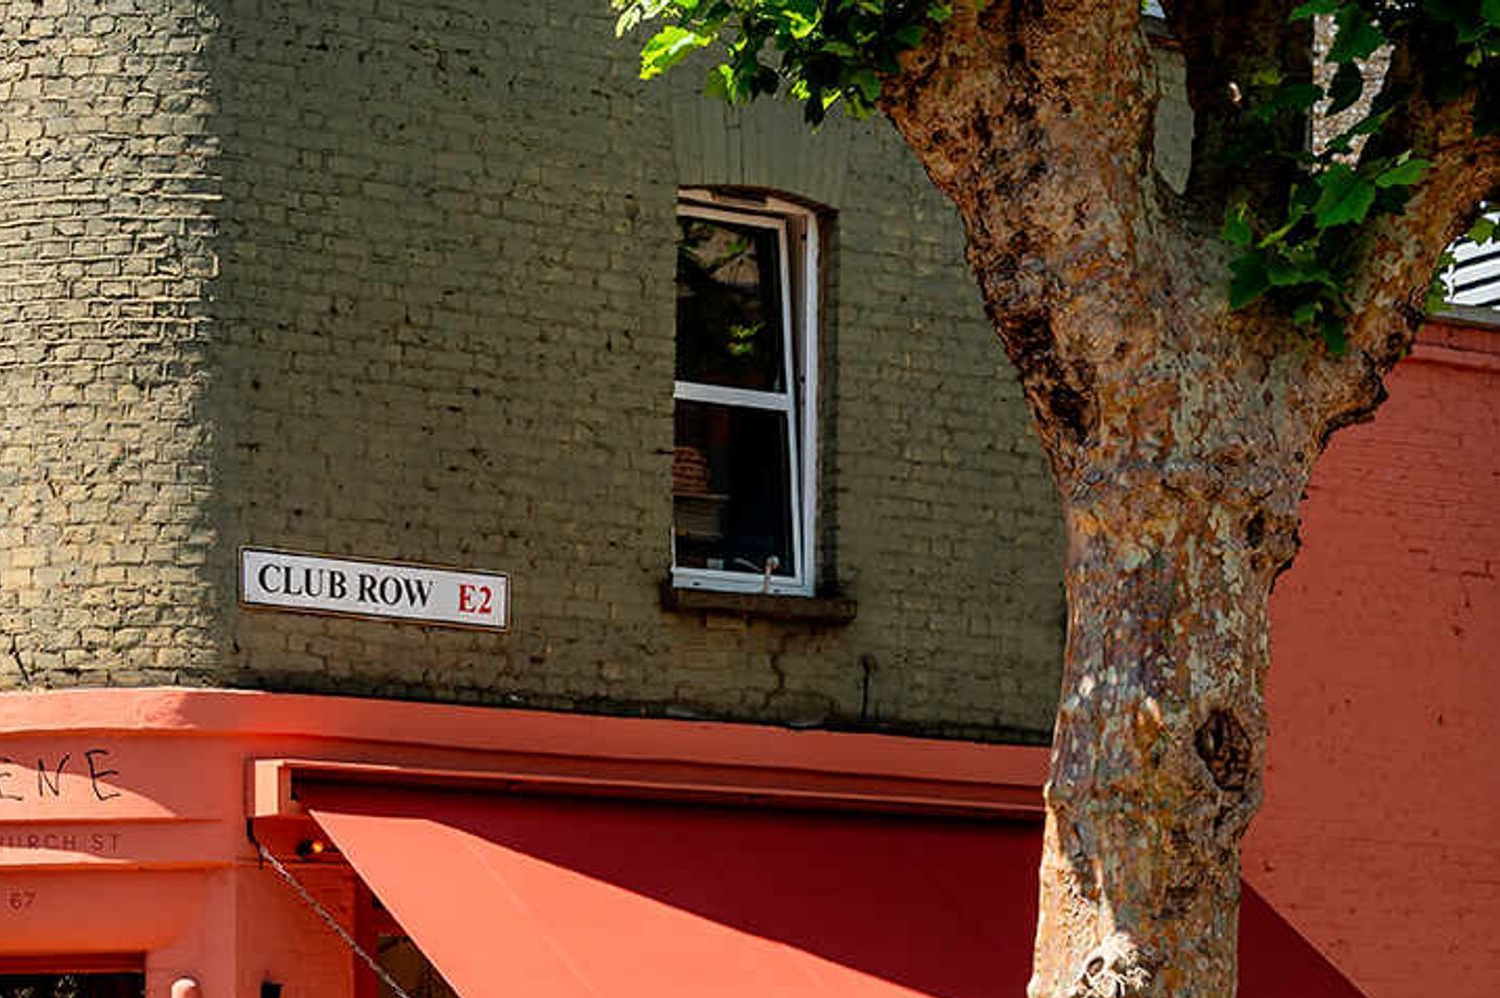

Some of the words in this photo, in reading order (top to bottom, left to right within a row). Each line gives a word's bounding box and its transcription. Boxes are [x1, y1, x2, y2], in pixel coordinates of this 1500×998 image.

[258, 563, 348, 599] CLUB
[358, 573, 434, 607] ROW
[458, 583, 493, 614] E2
[90, 833, 122, 853] ST
[9, 891, 36, 910] 67
